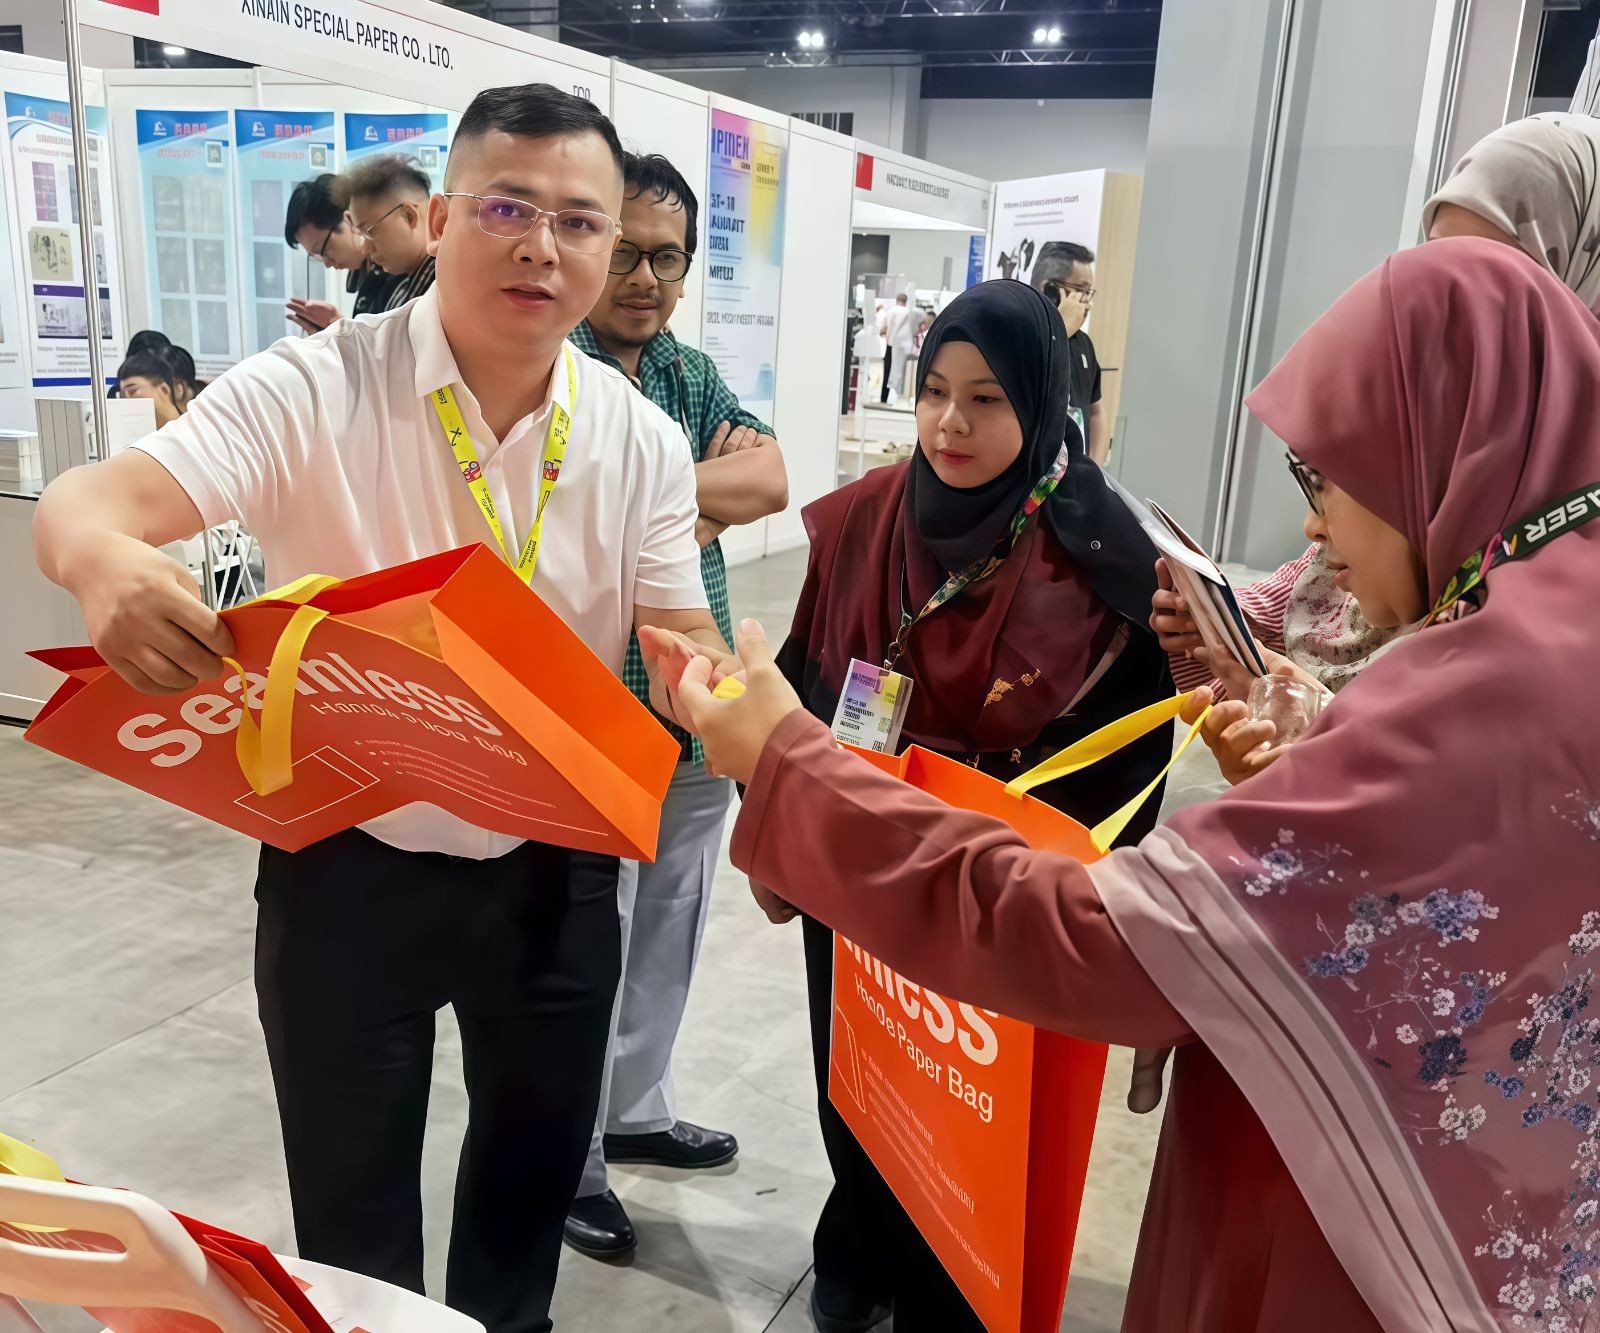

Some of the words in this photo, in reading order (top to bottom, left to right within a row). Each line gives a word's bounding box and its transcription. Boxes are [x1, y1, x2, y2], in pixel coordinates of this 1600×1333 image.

[294, 4, 354, 42] SPECIAL
[356, 22, 399, 55] PAPER
[897, 1021, 942, 1085] Paper
[947, 1064, 993, 1123] Bag
